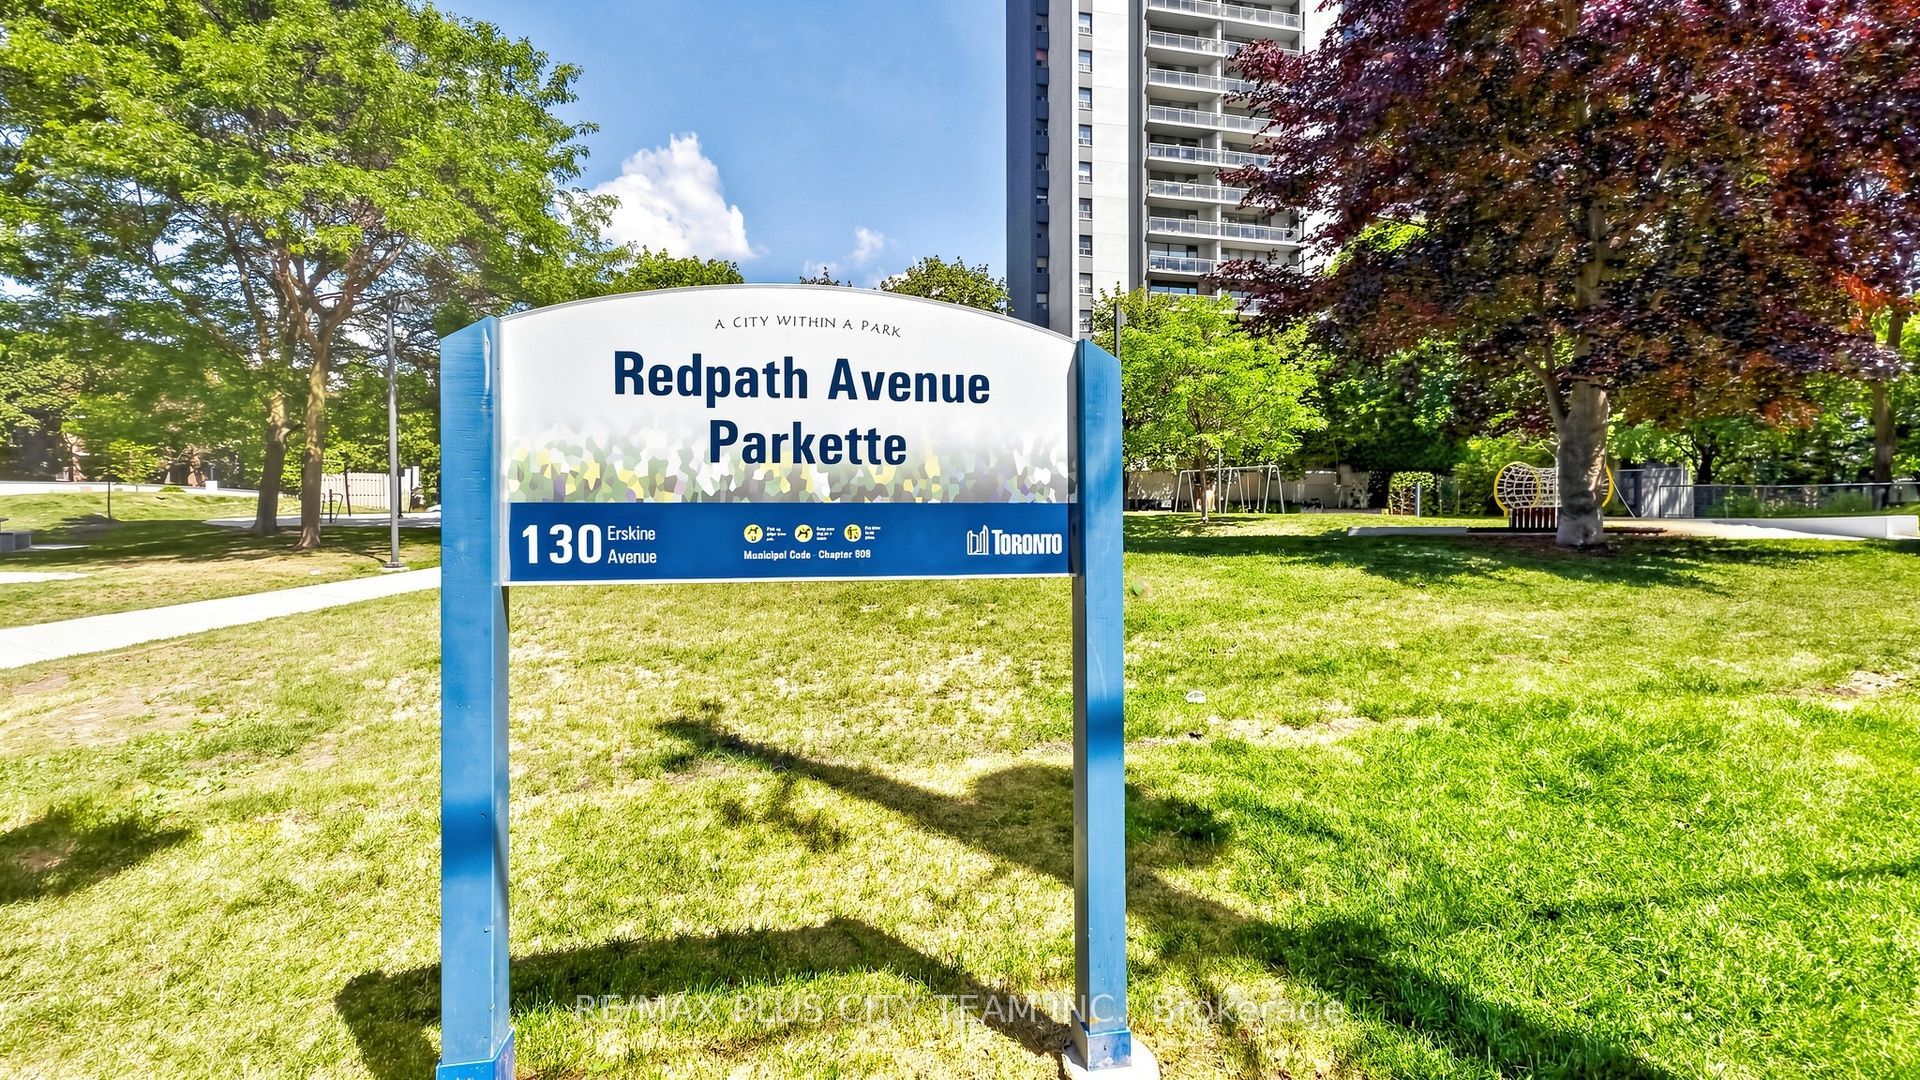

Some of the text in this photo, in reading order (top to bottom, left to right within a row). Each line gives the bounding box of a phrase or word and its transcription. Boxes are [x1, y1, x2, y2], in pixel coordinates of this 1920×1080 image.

[714, 315, 901, 338] A CITY WITHIN A PARK
[614, 350, 991, 408] Redpath Avenue
[709, 419, 907, 465] Parkette
[522, 523, 602, 565] 130
[607, 525, 656, 541] Erskine
[991, 529, 1063, 555] TORONTO
[607, 549, 657, 564] Avenue
[743, 550, 787, 561] Municipal
[789, 550, 811, 559] Code
[818, 550, 853, 560] Chapter
